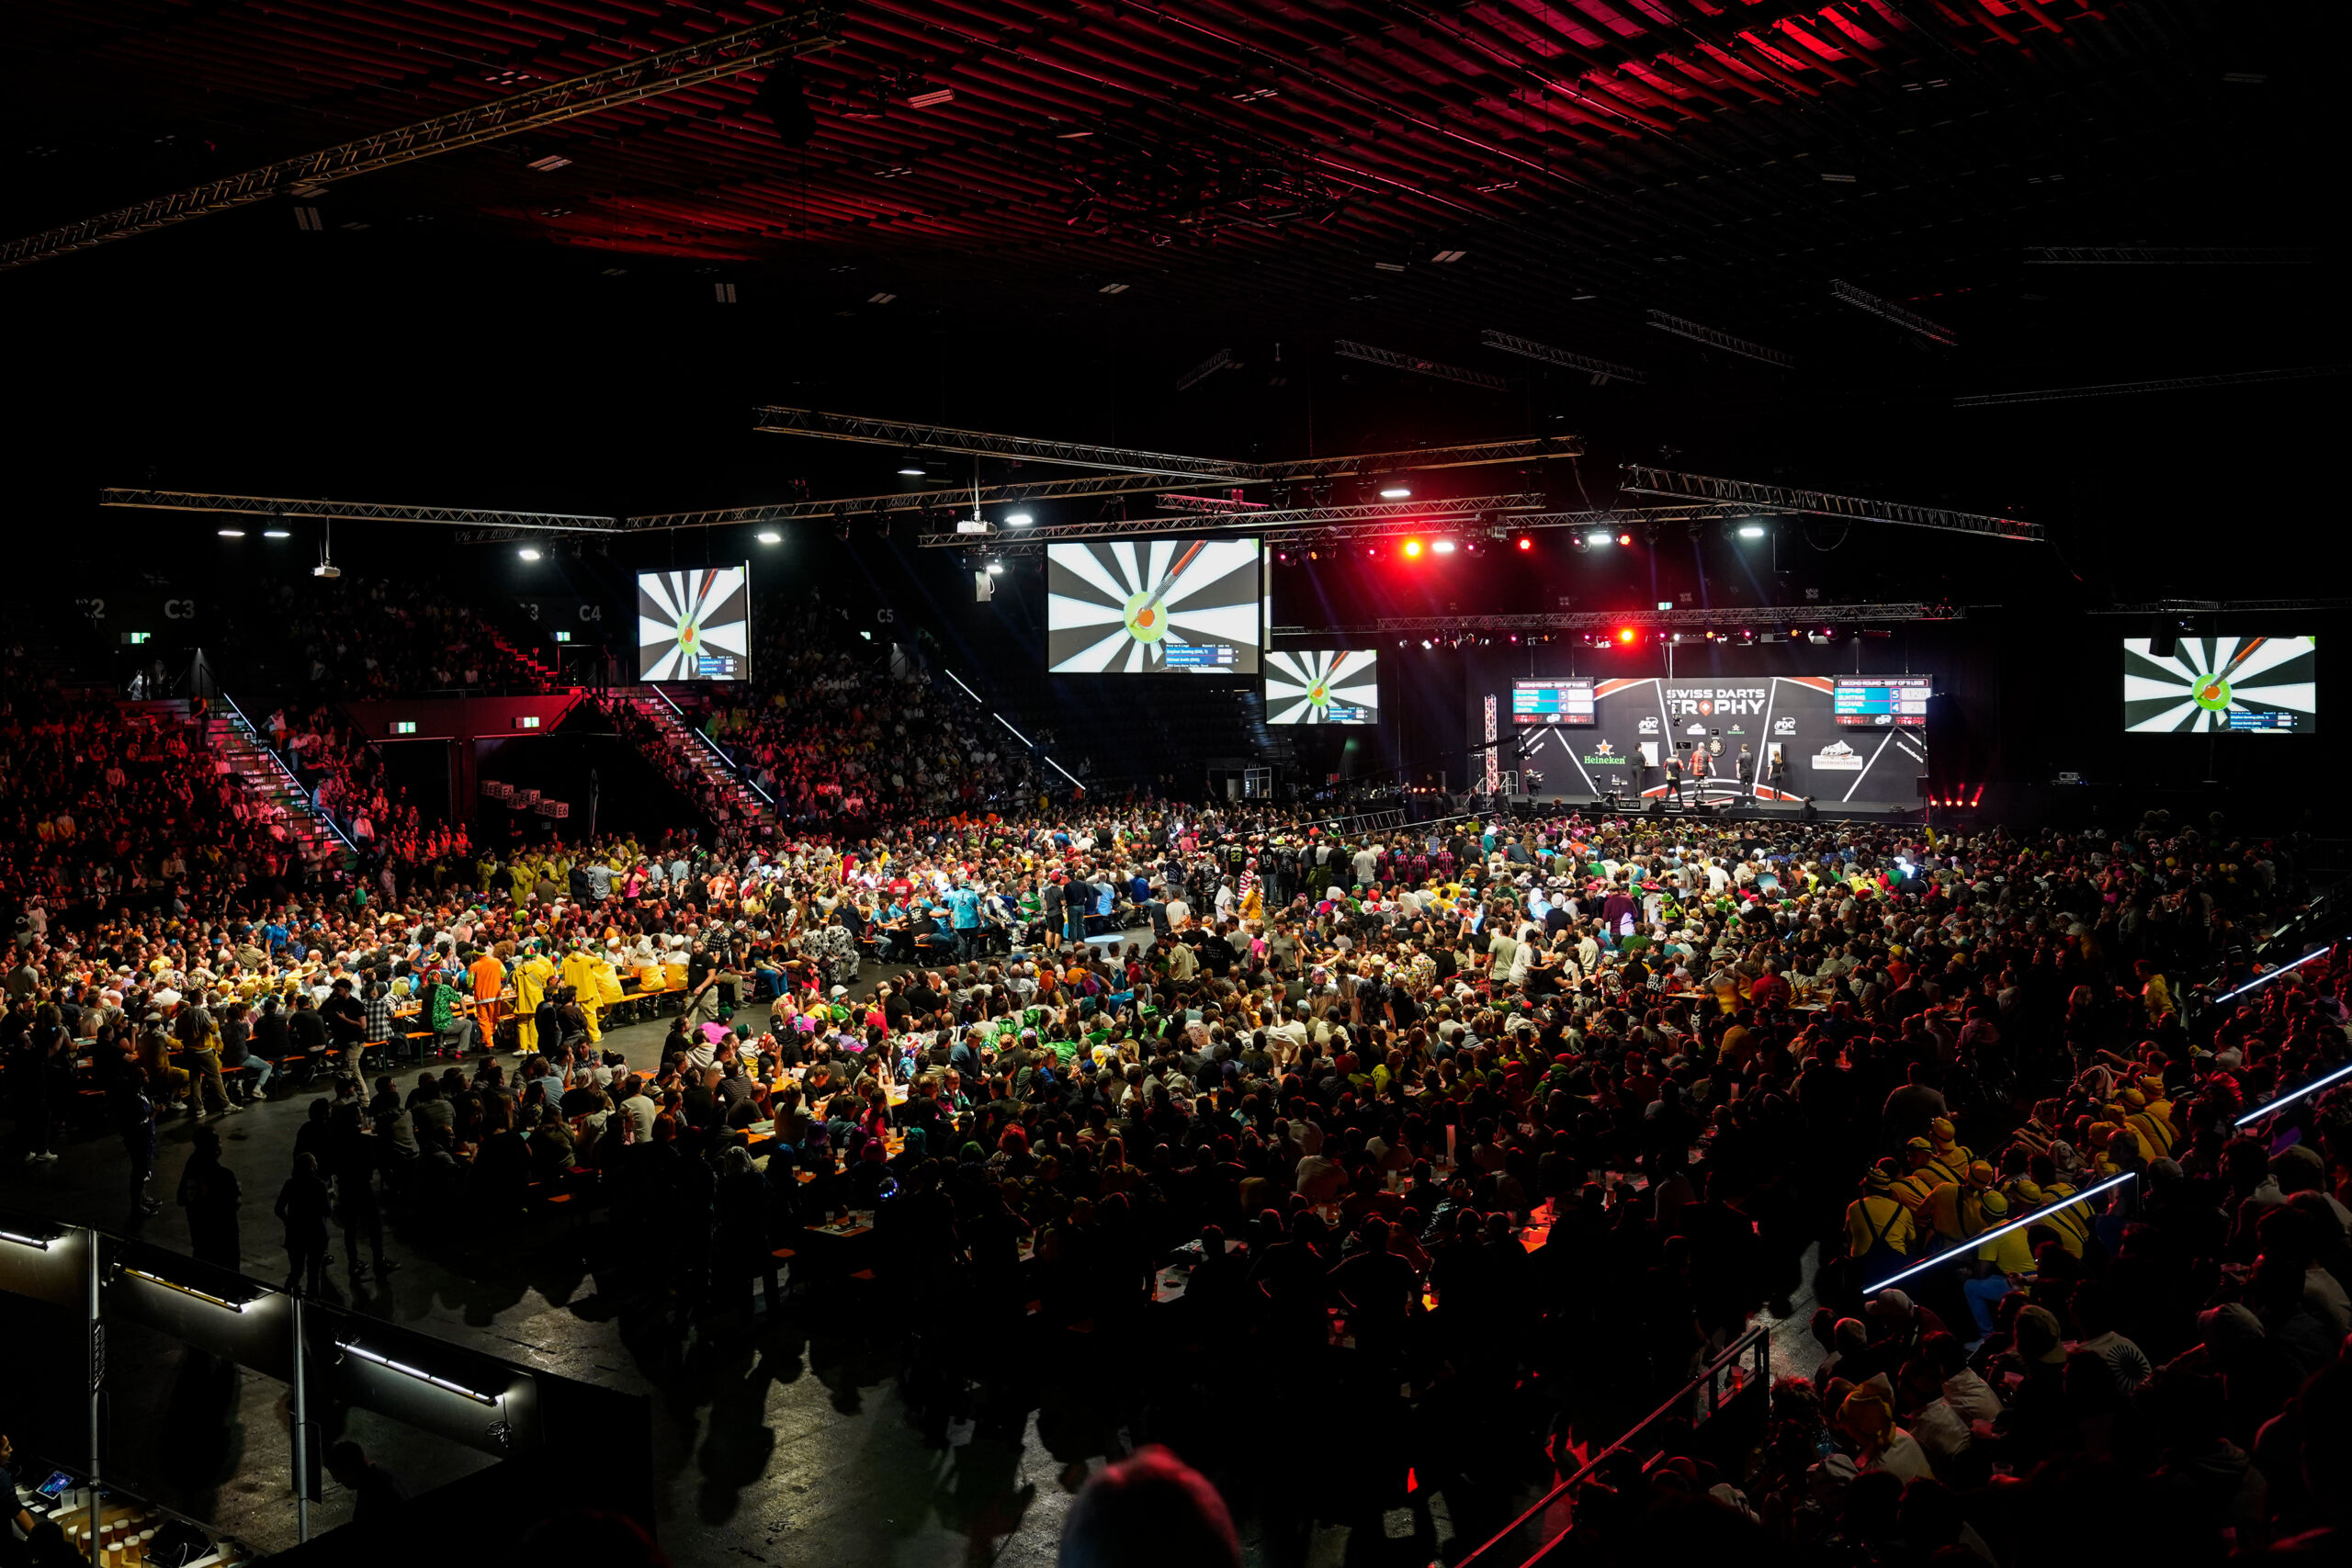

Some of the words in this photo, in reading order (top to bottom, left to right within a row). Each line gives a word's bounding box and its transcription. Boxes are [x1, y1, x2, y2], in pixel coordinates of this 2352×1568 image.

[164, 599, 195, 619] C3
[579, 604, 601, 621] C4
[876, 608, 894, 623] C5
[1667, 689, 1713, 698] SWISS
[1716, 689, 1766, 698] DARTS
[1893, 690, 1899, 698] 5
[1560, 703, 1566, 711] 4
[1667, 700, 1765, 716] TROPHY
[1893, 703, 1899, 712] 4
[1584, 755, 1626, 764] Heineken
[559, 807, 567, 816] E6
[1230, 852, 1242, 863] 23
[1261, 854, 1272, 863] 19
